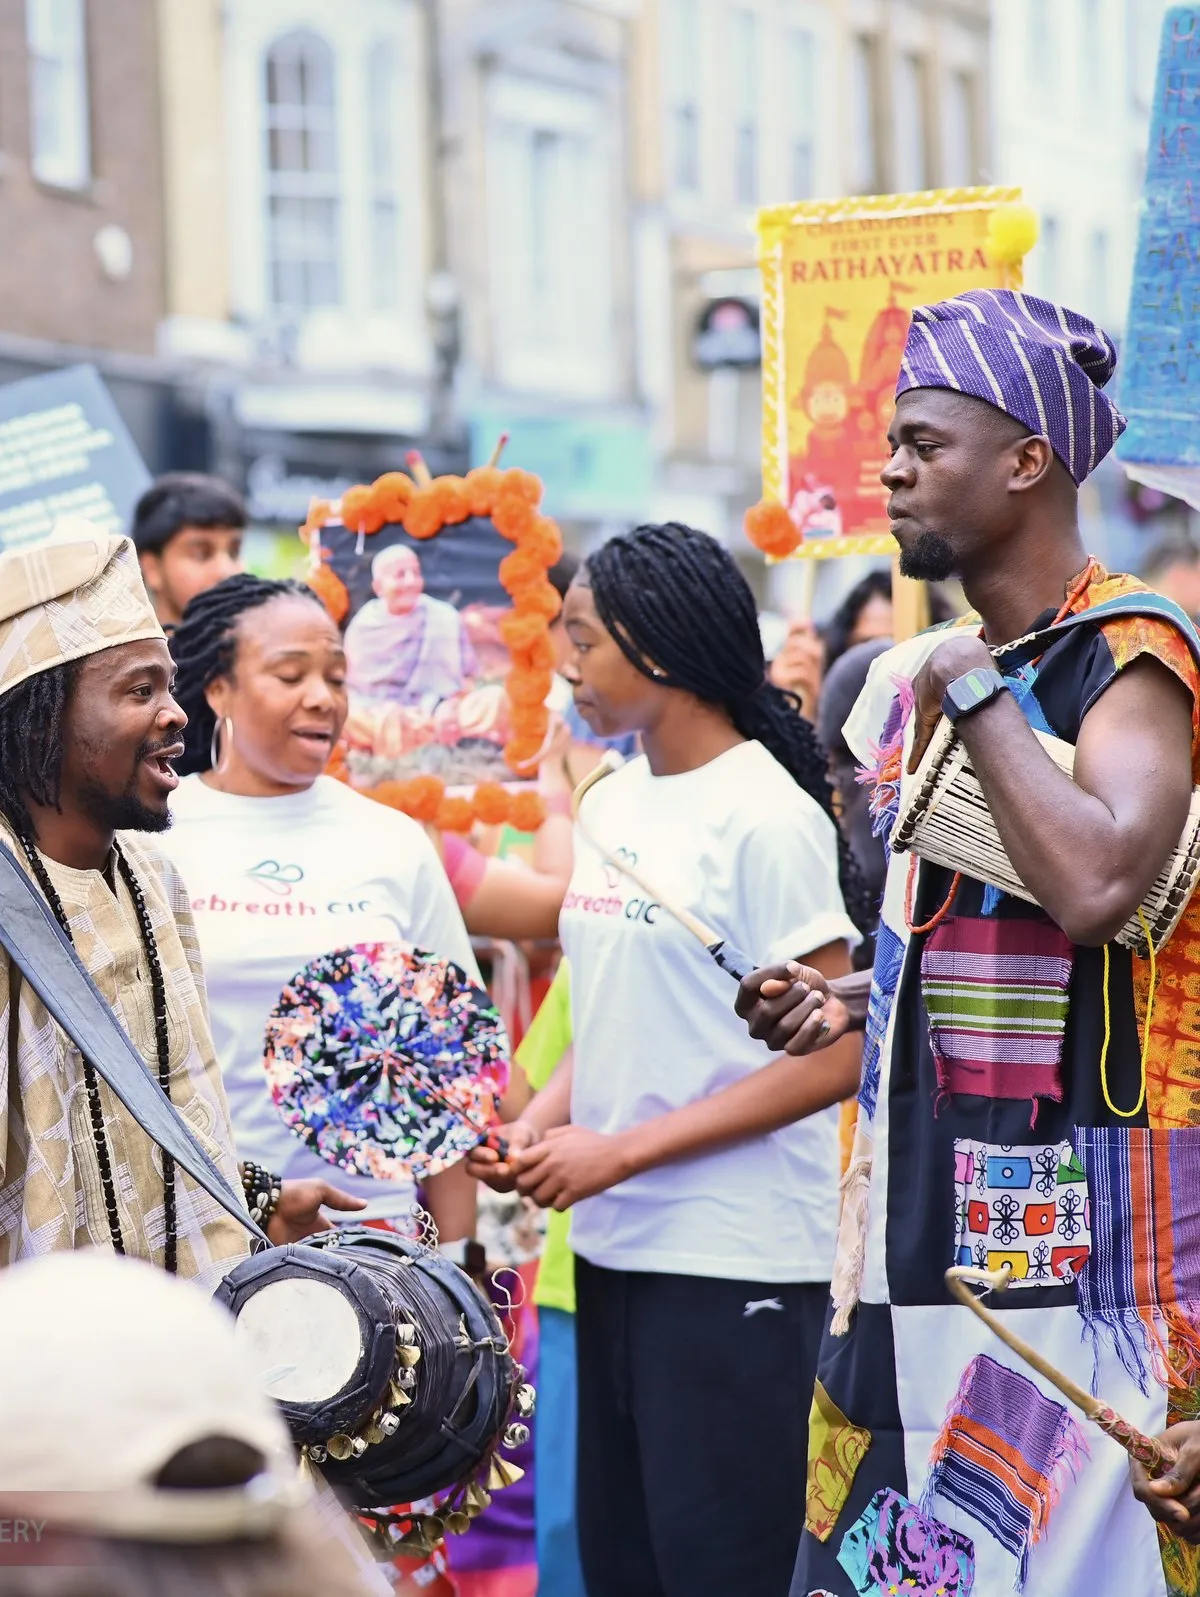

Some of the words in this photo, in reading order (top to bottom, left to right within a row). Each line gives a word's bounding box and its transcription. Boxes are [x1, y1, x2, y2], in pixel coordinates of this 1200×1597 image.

[830, 236, 883, 254] FIRST
[888, 232, 938, 251] EVER
[790, 247, 988, 284] RATHAYATRA
[191, 893, 317, 917] ebreath
[624, 898, 661, 924] CIC
